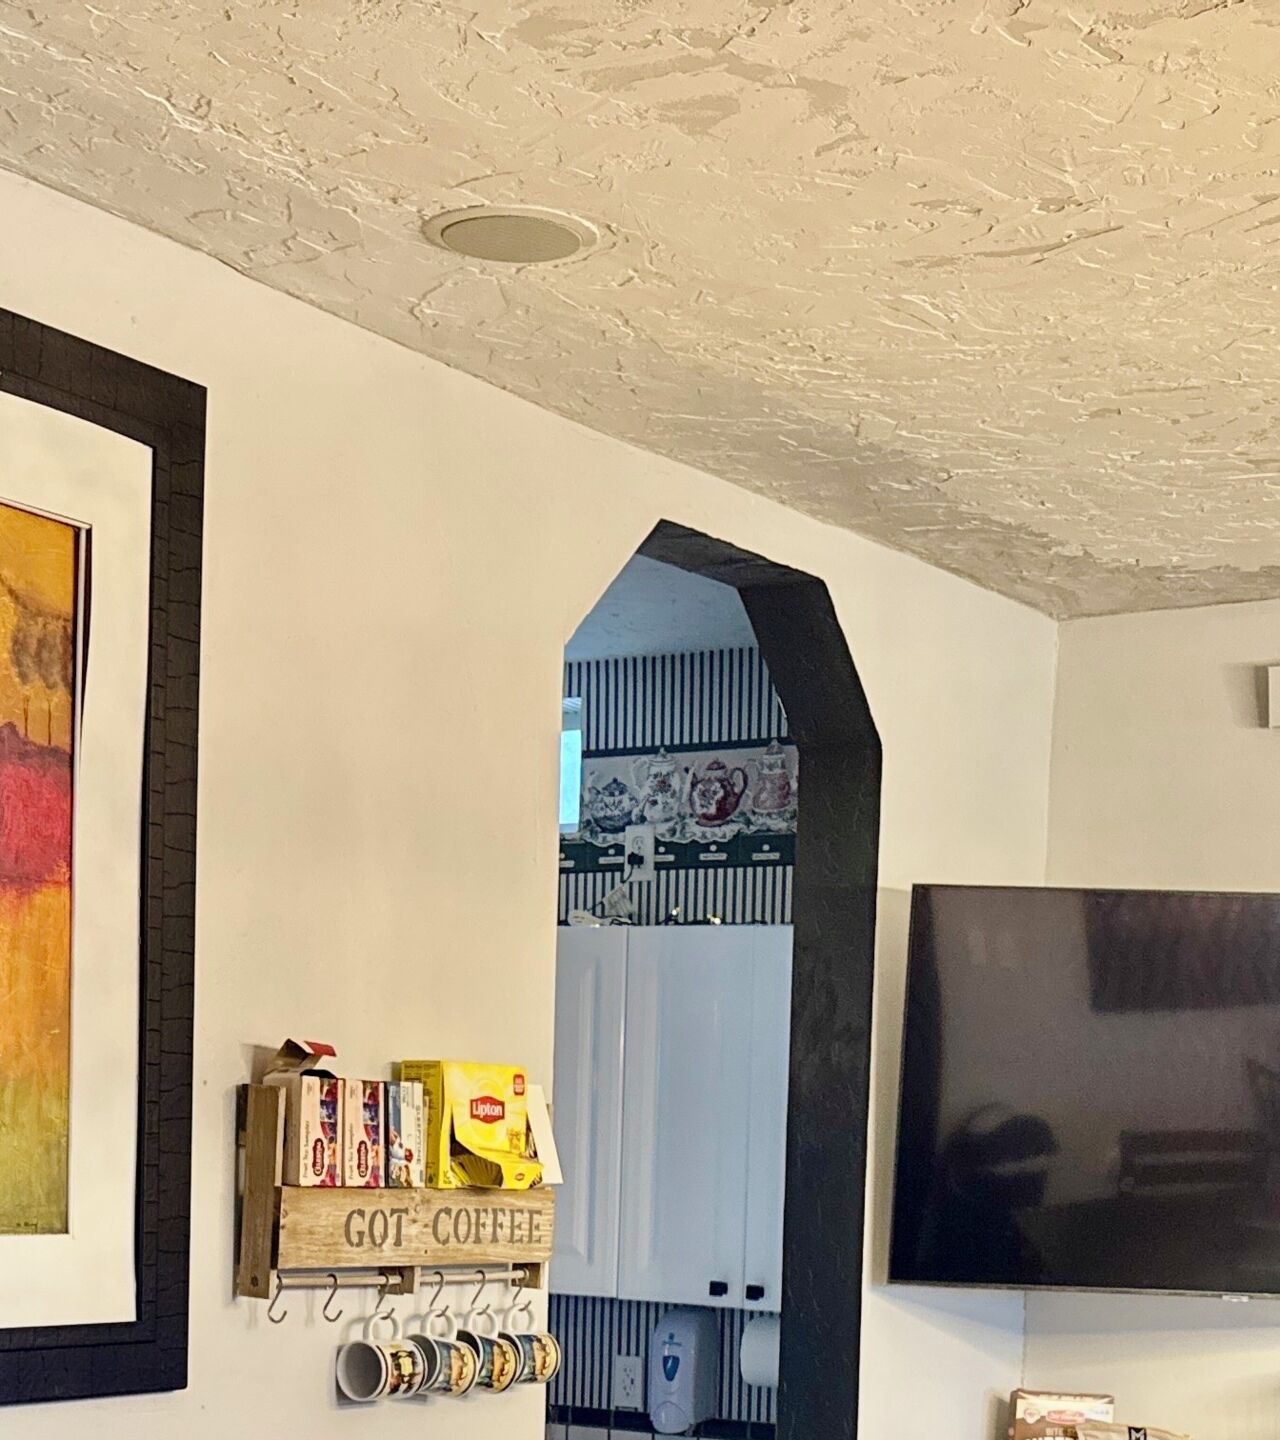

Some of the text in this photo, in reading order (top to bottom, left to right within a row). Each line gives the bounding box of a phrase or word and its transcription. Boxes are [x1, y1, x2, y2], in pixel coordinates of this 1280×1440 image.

[472, 1100, 503, 1119] Lipton
[344, 1206, 543, 1248] GOT COFFEE
